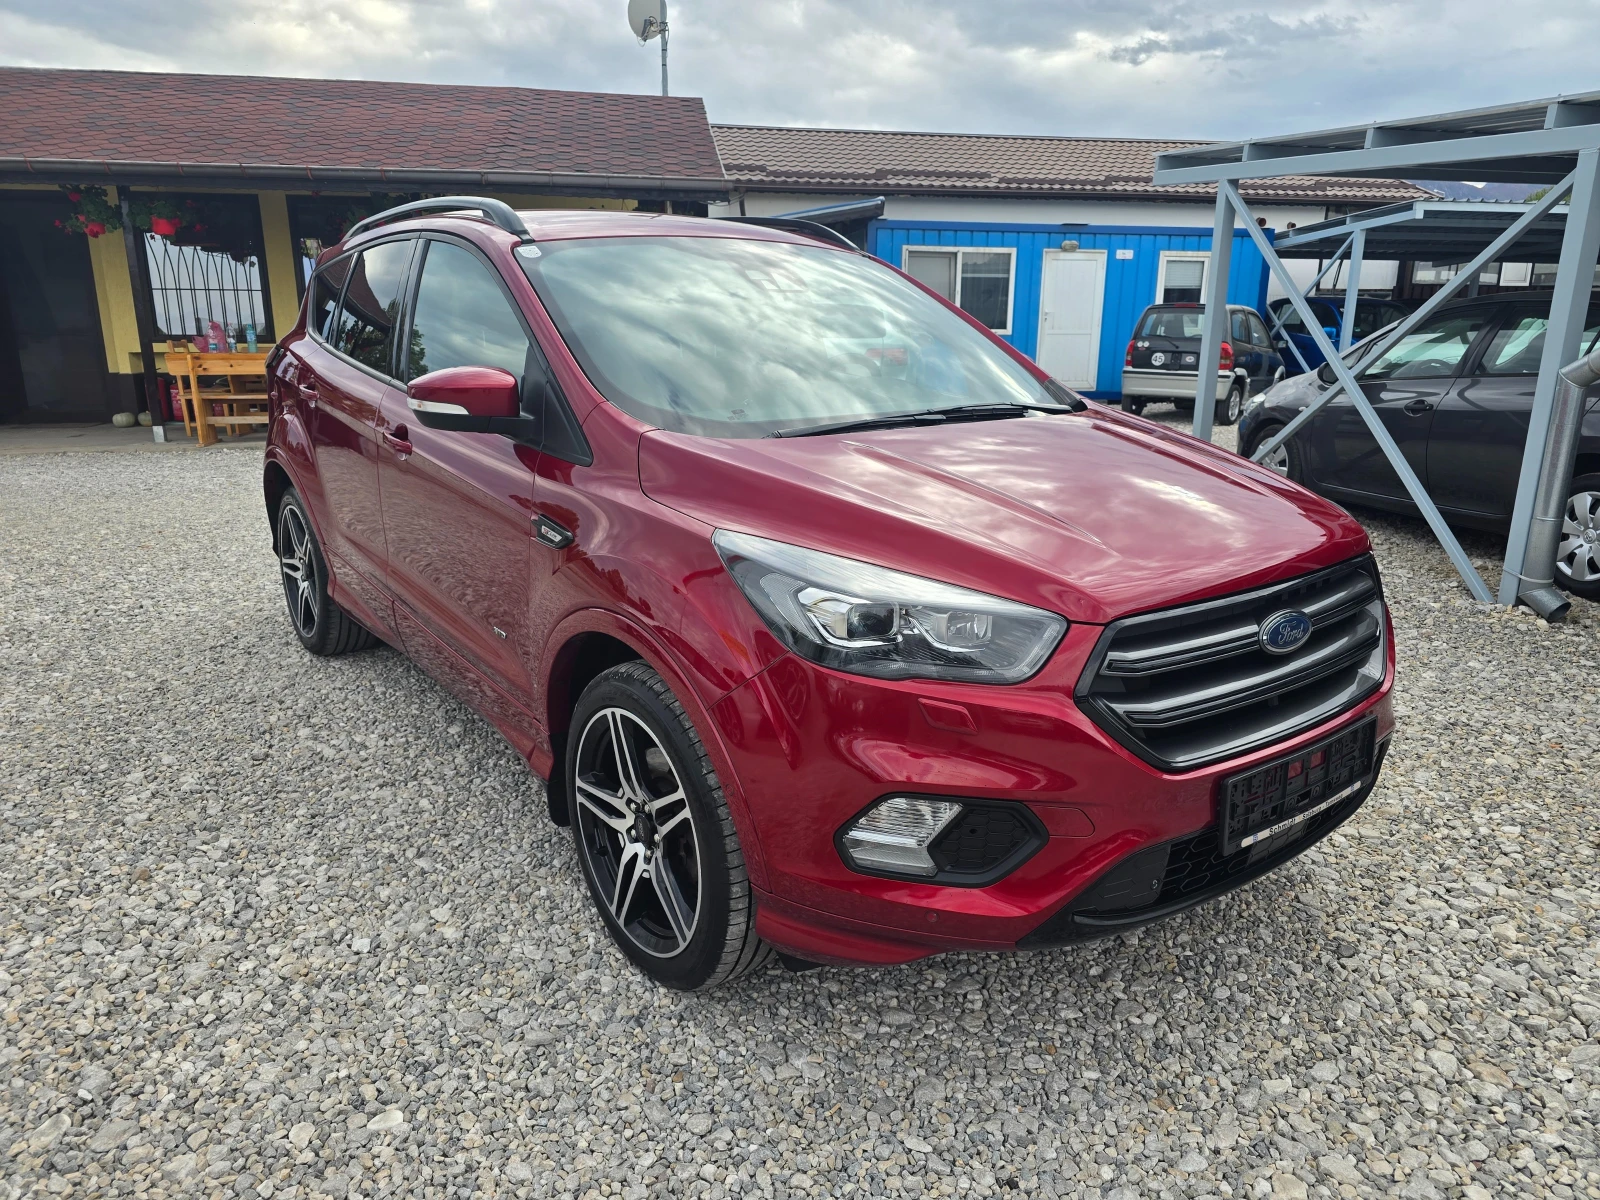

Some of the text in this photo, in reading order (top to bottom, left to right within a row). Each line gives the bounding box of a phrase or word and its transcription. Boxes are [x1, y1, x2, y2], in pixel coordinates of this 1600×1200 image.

[1152, 355, 1163, 363] 45
[1278, 620, 1304, 644] Ford
[1269, 818, 1296, 836] Schmidt
